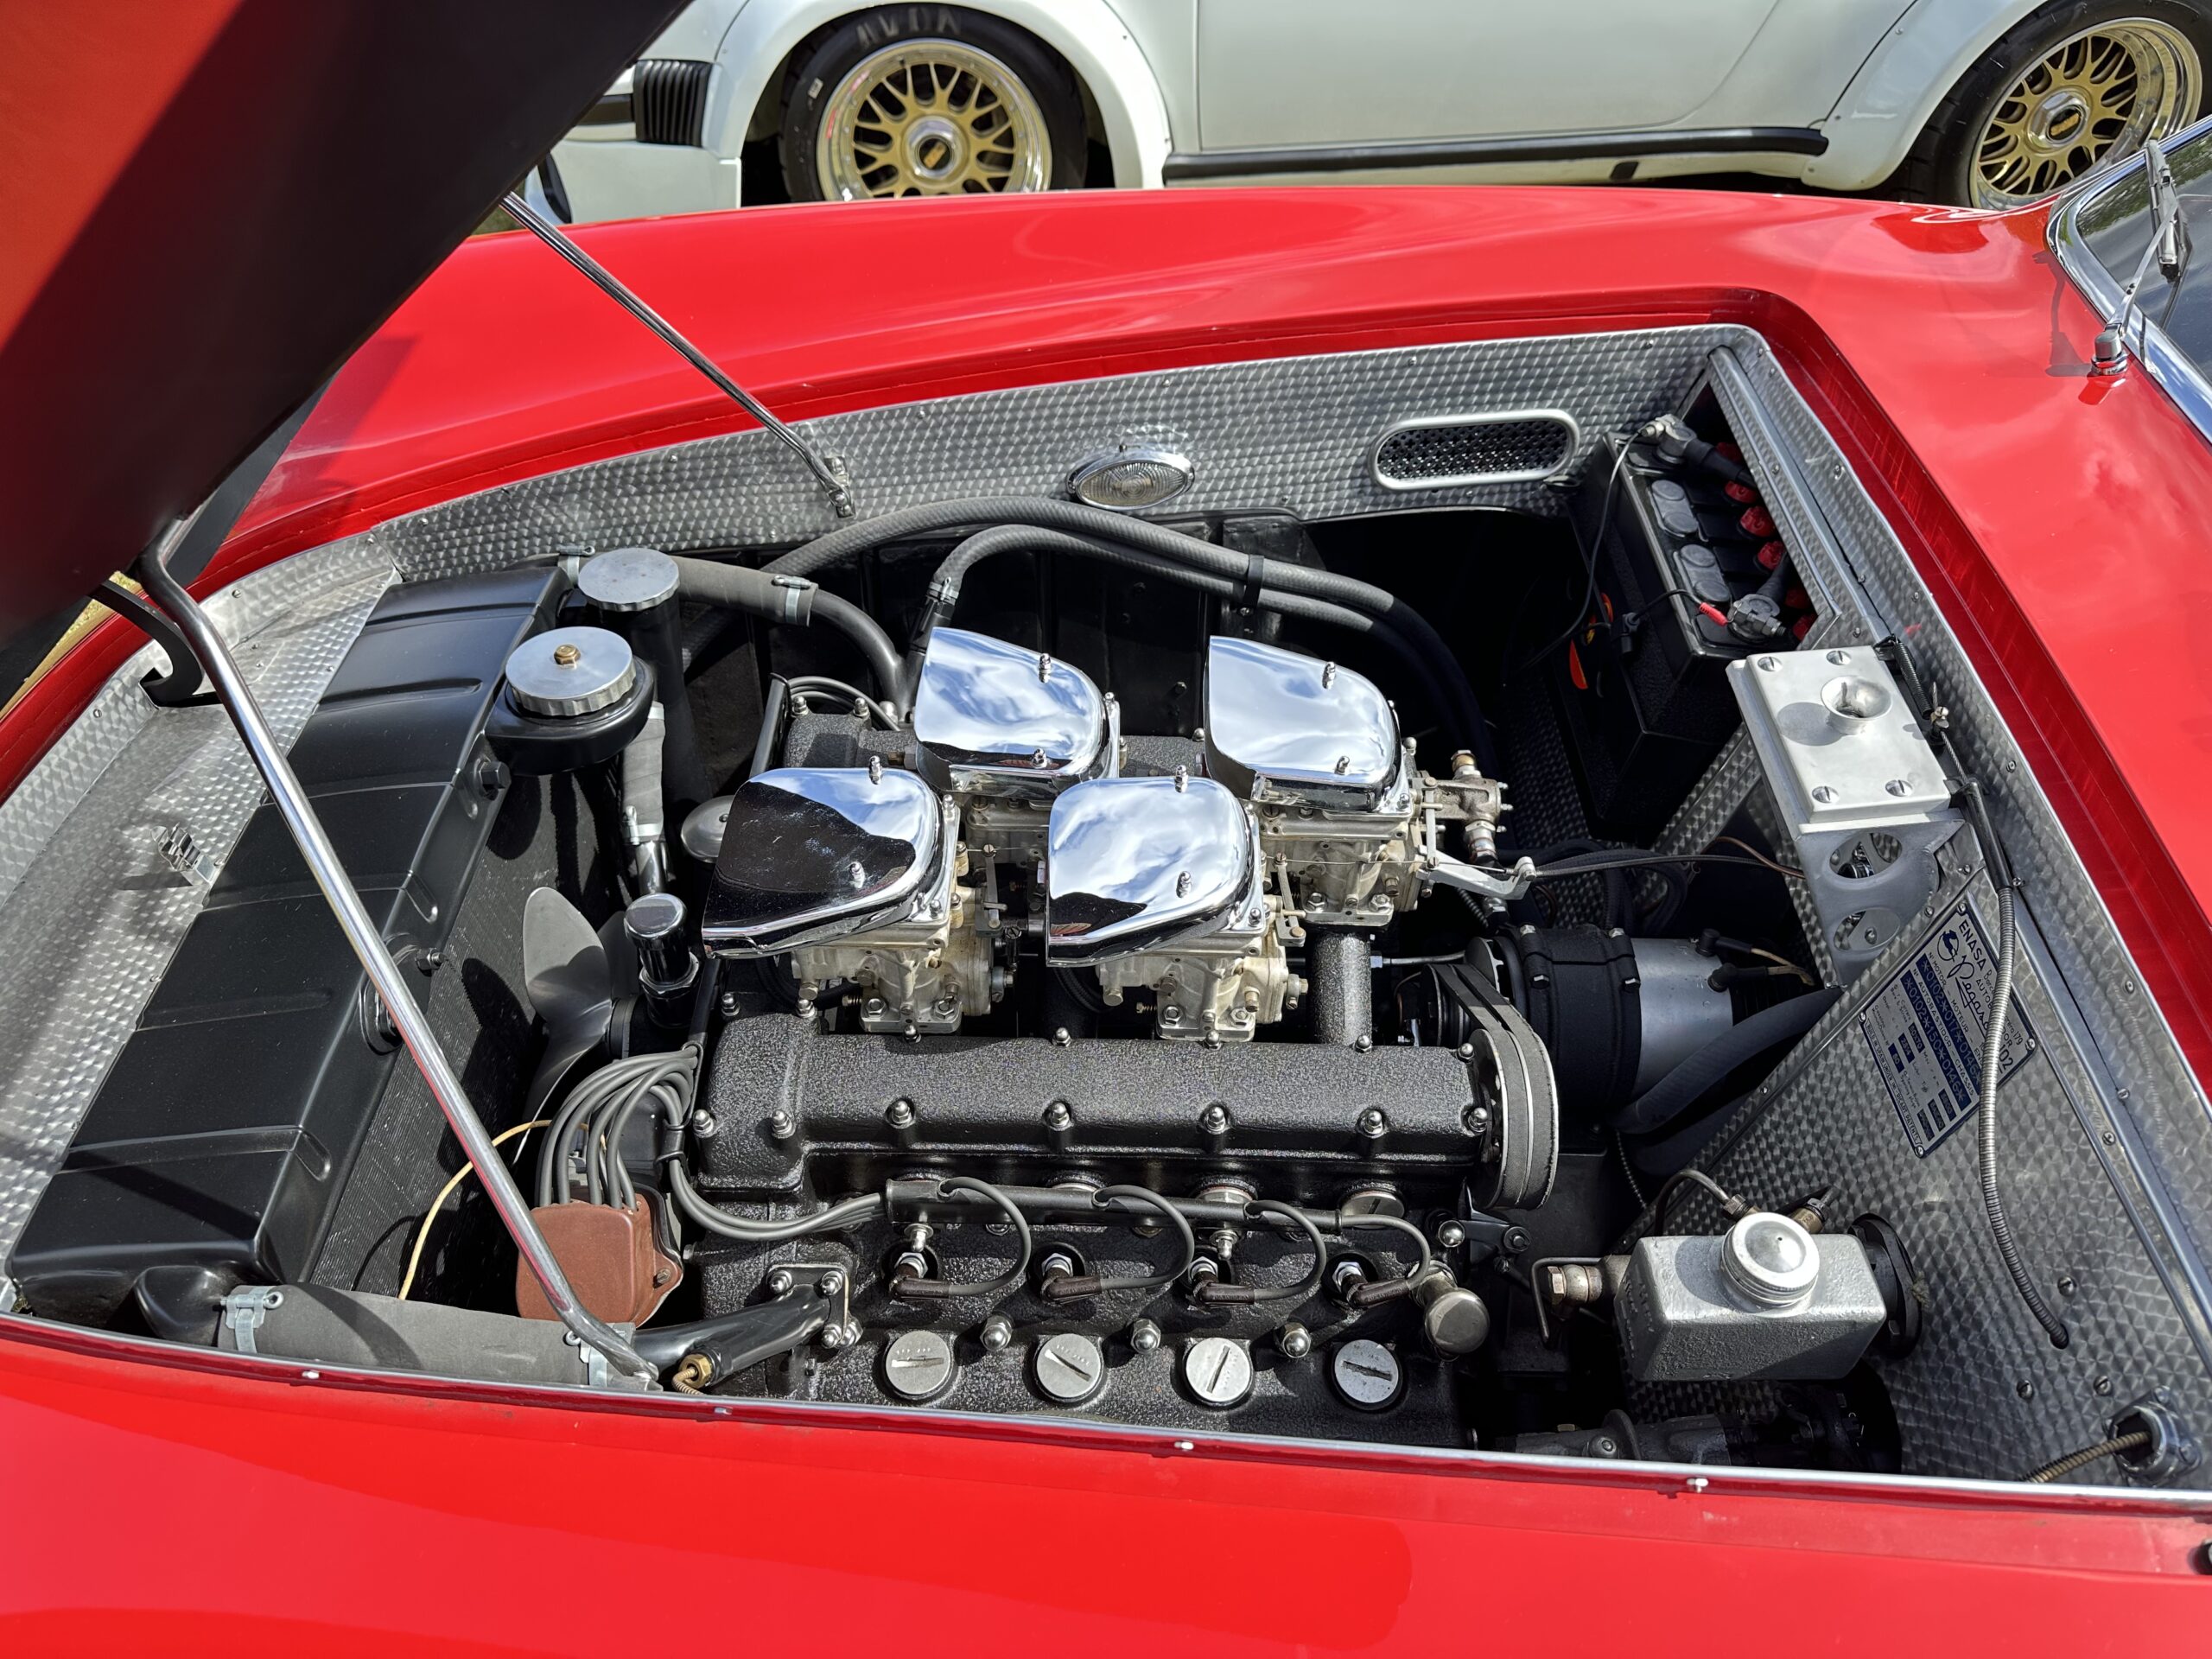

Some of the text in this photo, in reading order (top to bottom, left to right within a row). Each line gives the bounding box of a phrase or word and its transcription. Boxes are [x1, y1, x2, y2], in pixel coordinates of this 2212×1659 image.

[1932, 960, 1946, 988] MOTOR
[1950, 999, 1968, 1033] MOTEUR
[1958, 918, 1986, 971] ENASA
[2012, 1030, 2023, 1045] 179
[1974, 976, 2014, 1049] AUTOBDOR
[1917, 981, 1951, 1047] AUTOBASTIDOR
[1955, 1058, 1974, 1096] CHASSIS
